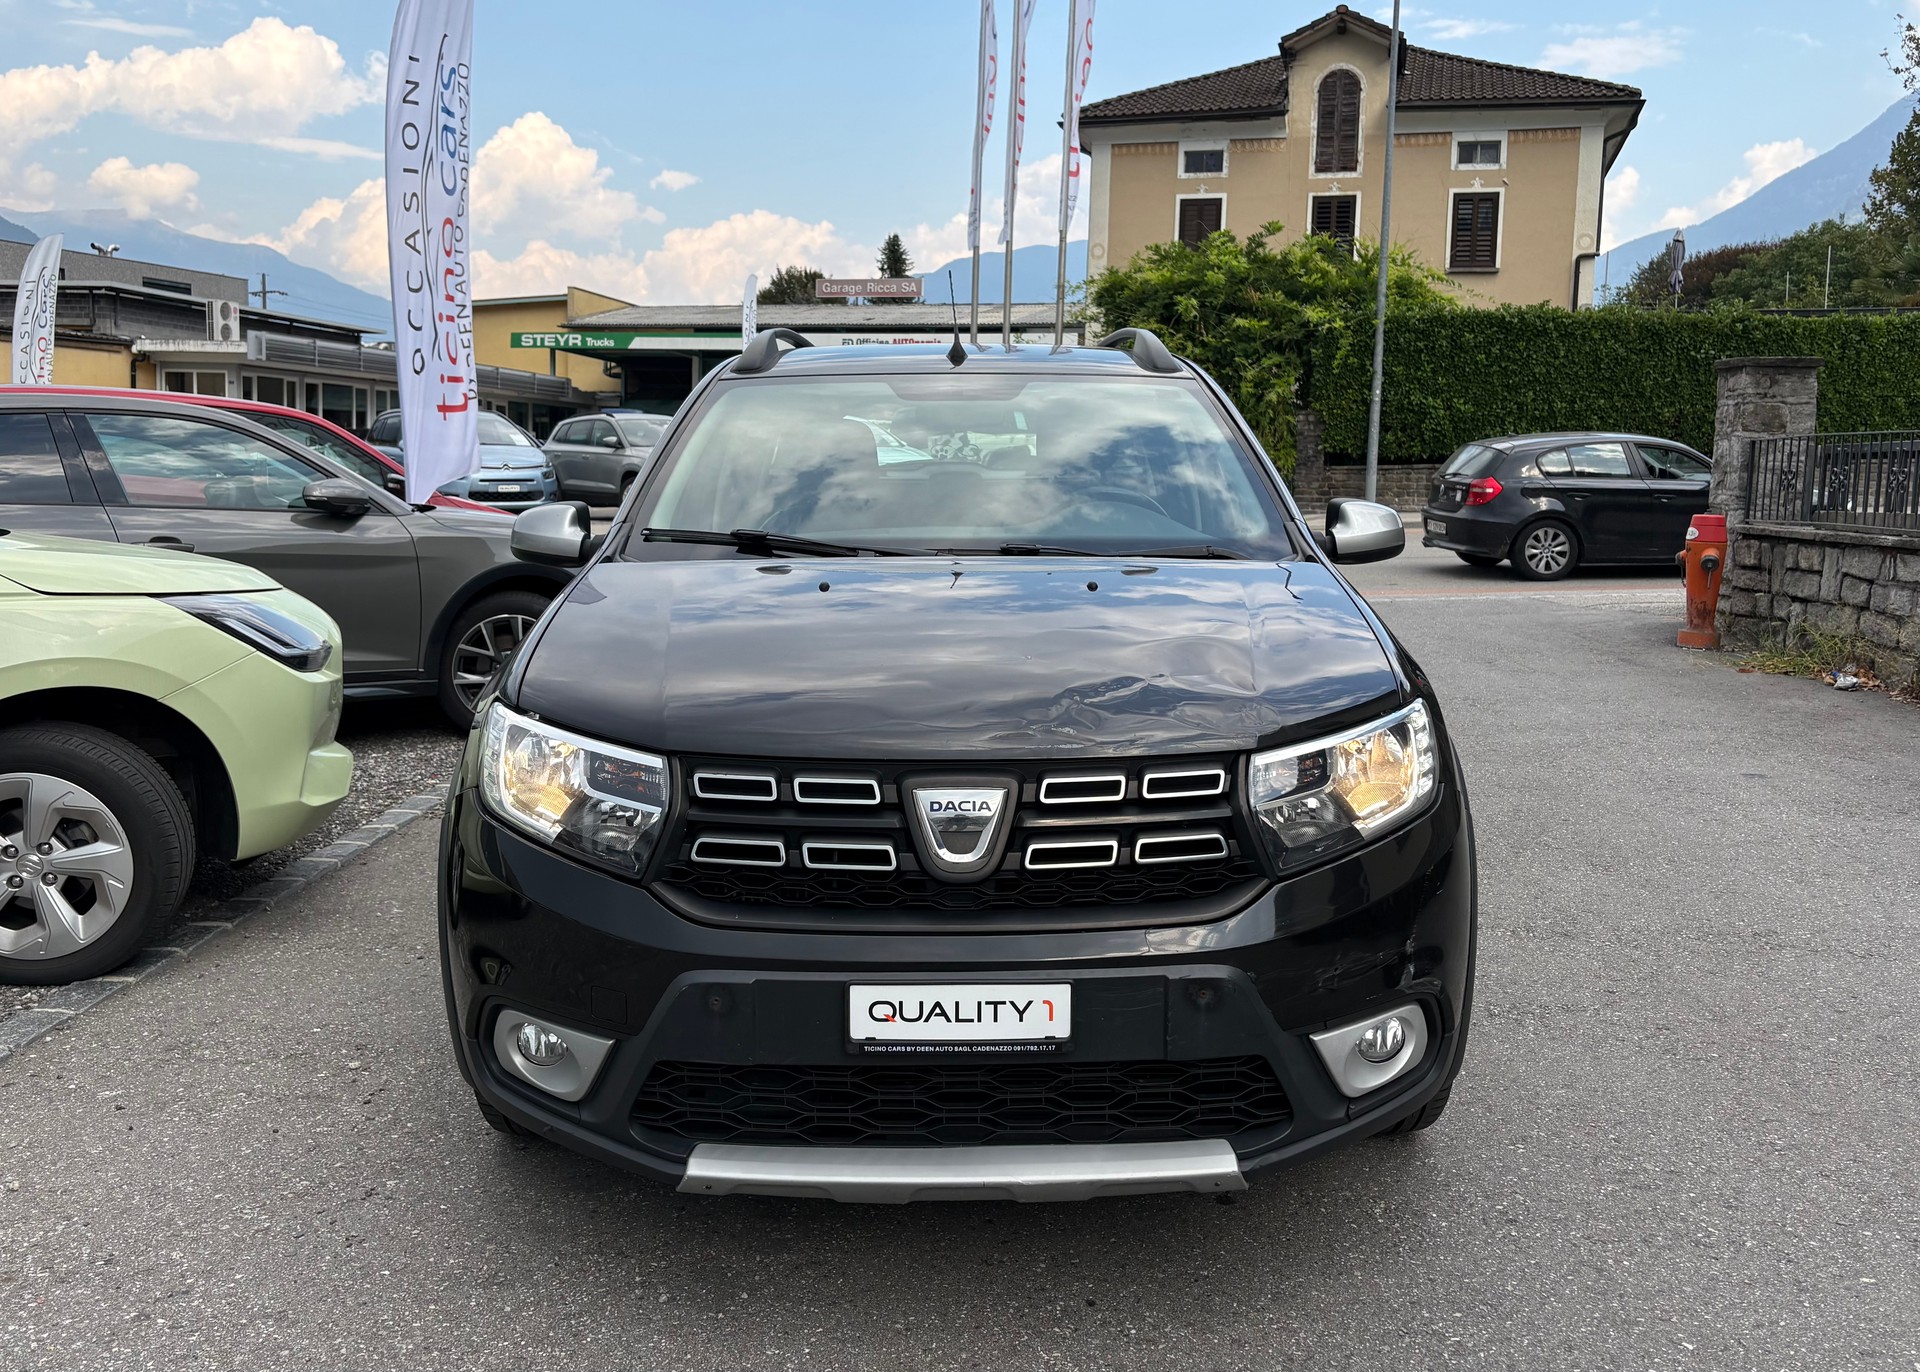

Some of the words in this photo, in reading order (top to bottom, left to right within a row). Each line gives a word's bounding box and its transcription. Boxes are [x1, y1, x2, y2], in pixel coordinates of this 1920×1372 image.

[440, 64, 457, 197] cars
[402, 55, 426, 376] OCCASIONI
[454, 225, 467, 296] AUTO
[822, 283, 862, 294] Garage
[867, 282, 897, 293] Ricca
[901, 282, 917, 293] SA
[20, 280, 36, 384] CCASIONI
[437, 217, 468, 421] ticino
[521, 334, 582, 346] STEYR
[586, 338, 614, 347] Trucks
[929, 801, 992, 812] DACIA
[868, 1000, 1034, 1023] QUALITY
[1042, 1000, 1053, 1022] 1
